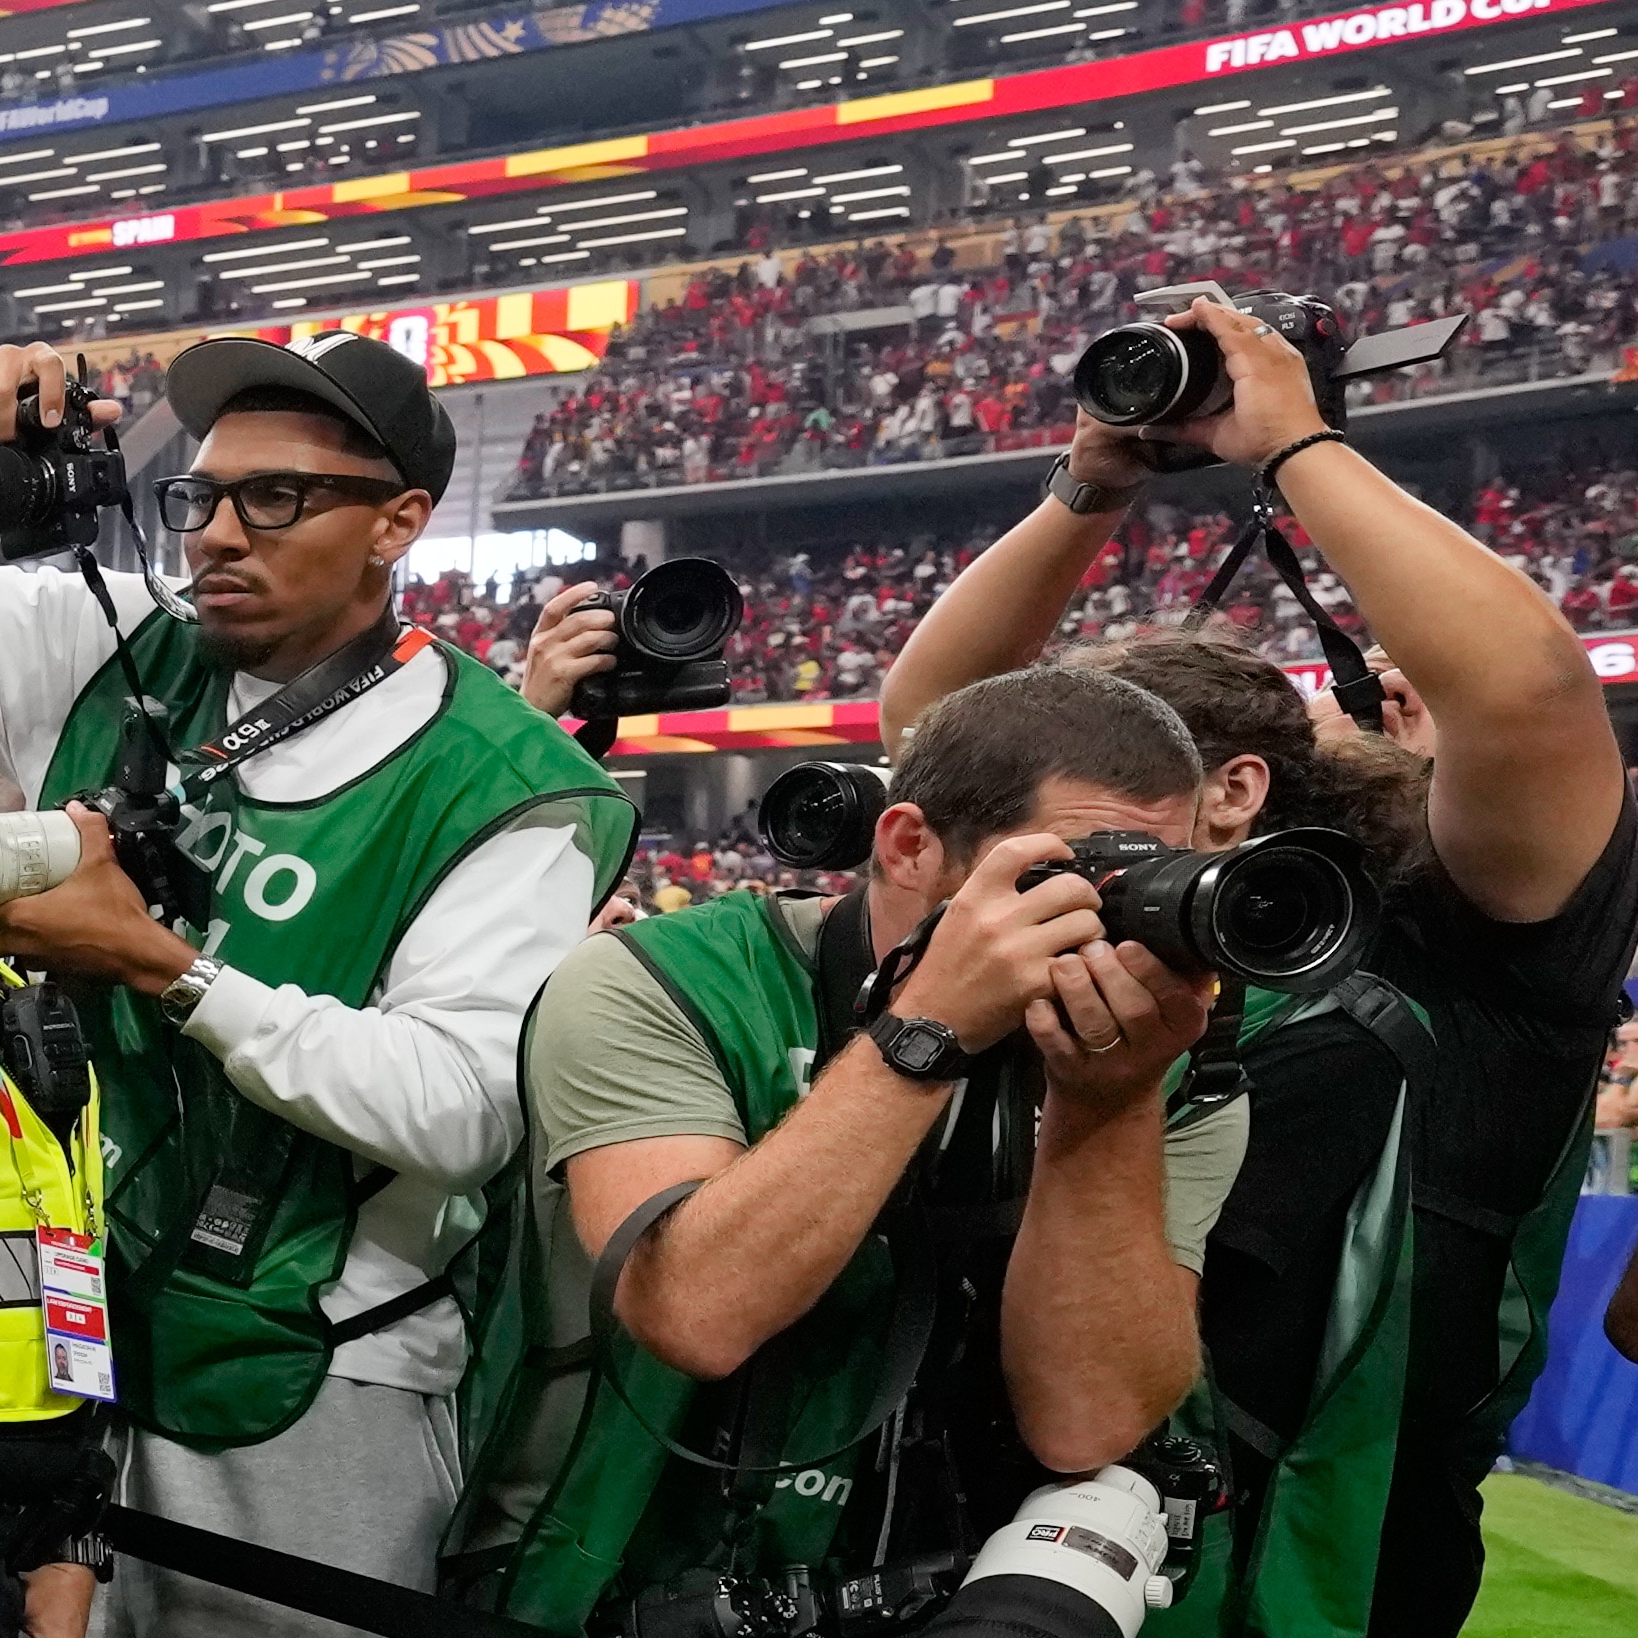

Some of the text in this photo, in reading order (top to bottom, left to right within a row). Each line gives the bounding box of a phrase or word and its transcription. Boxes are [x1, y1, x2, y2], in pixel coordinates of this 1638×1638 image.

[1205, 29, 1300, 73] FIFA
[1302, 1, 1463, 53] WORLD
[112, 213, 175, 247] SPAIN
[66, 462, 76, 493] SONY
[347, 664, 385, 694] FIFA
[172, 778, 317, 921] HOTO
[1118, 843, 1157, 851] SONY
[1031, 1528, 1059, 1539] PRO
